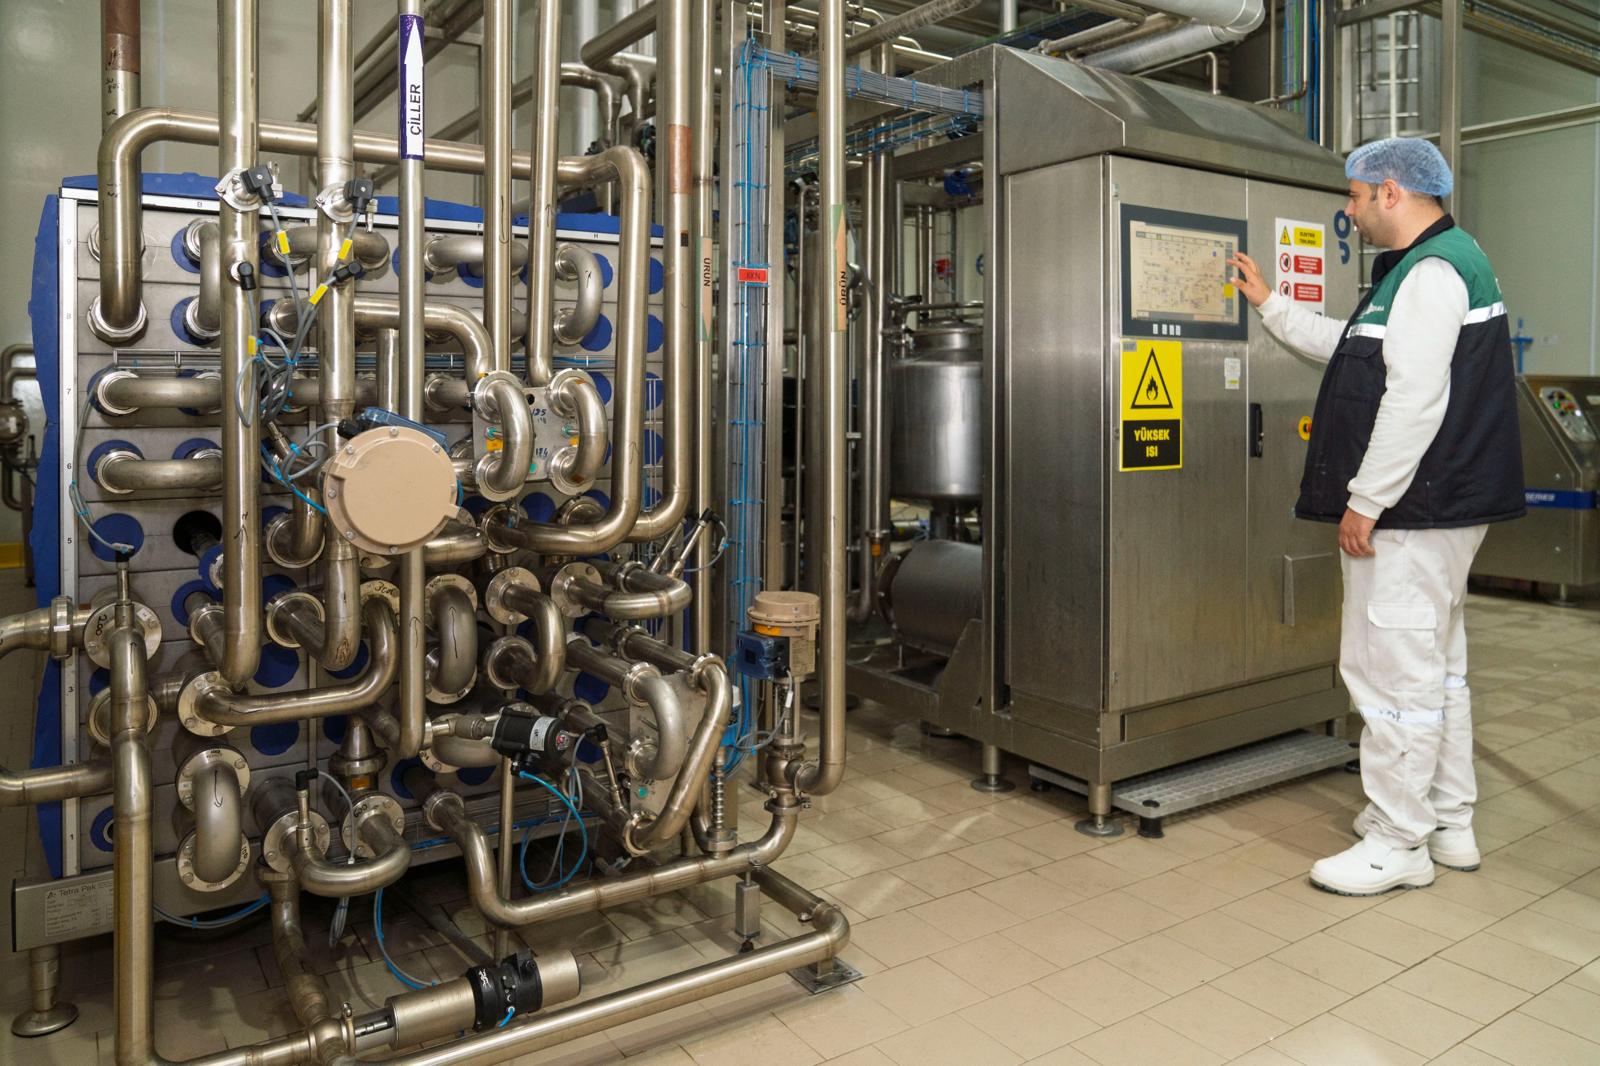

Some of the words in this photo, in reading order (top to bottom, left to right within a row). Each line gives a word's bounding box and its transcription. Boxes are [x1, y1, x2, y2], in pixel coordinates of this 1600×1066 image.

[1134, 427, 1170, 441] YÜKSEK
[1146, 446, 1158, 457] ISI
[60, 888, 79, 897] Tetra
